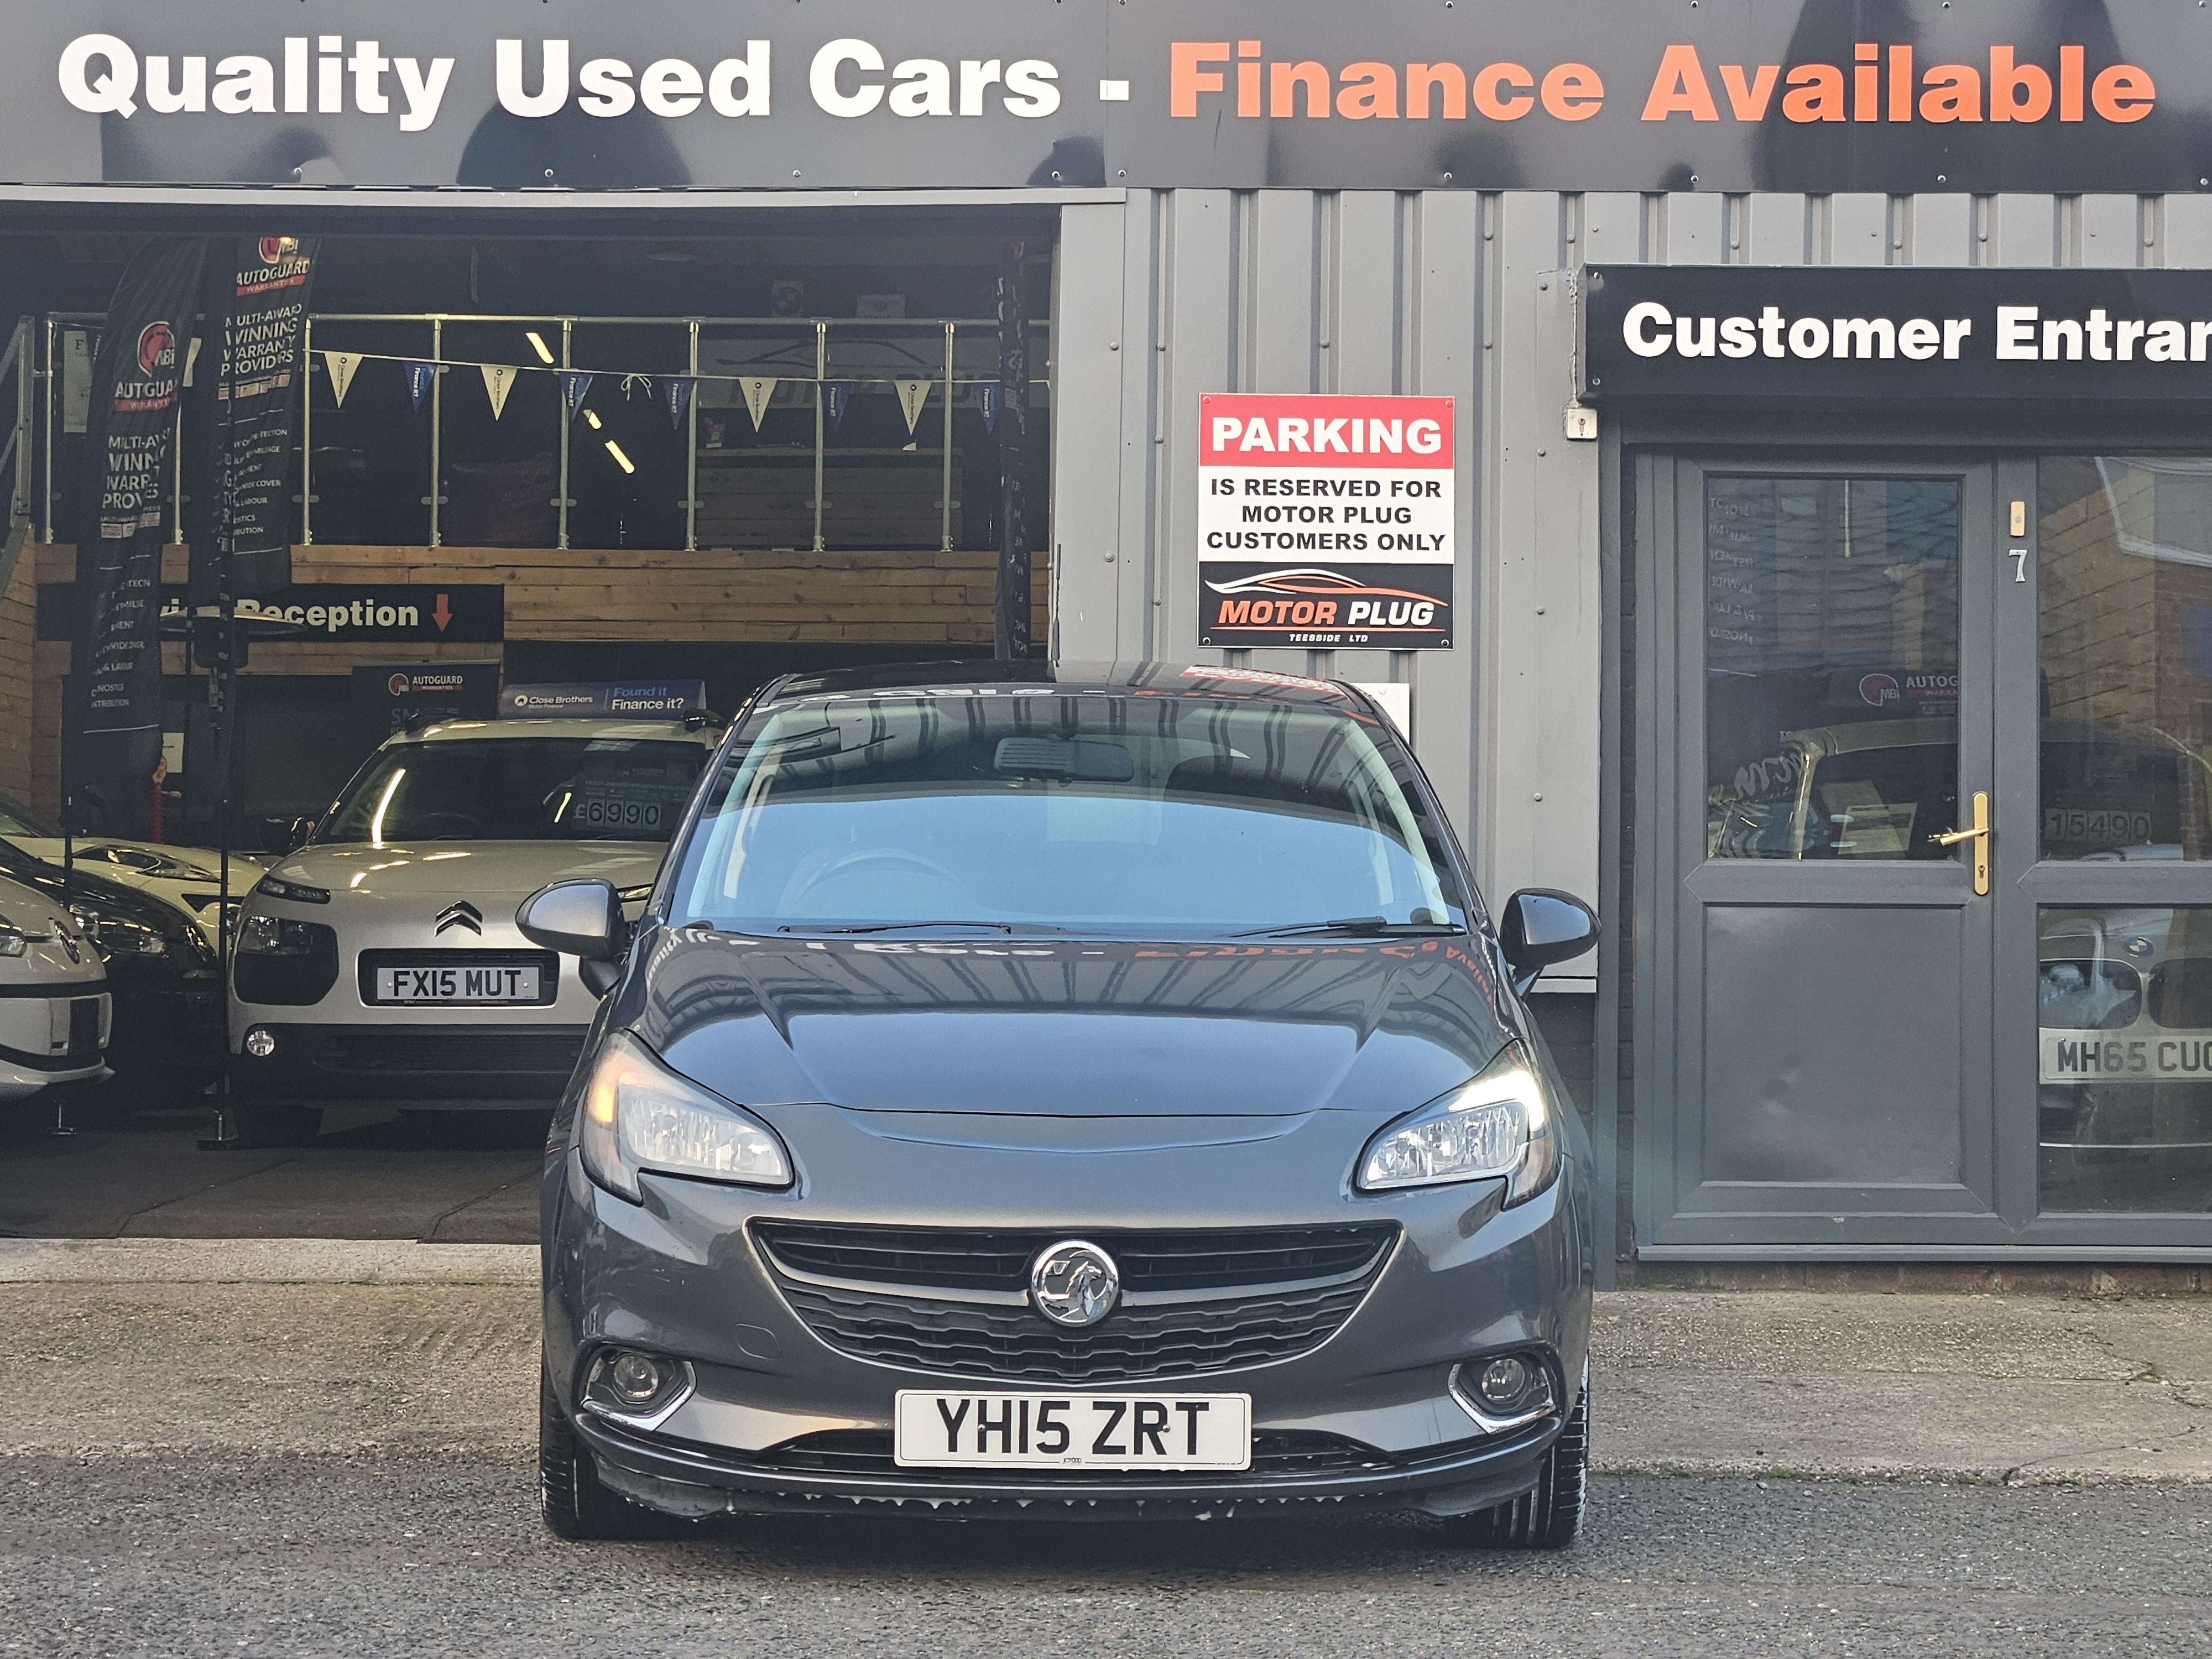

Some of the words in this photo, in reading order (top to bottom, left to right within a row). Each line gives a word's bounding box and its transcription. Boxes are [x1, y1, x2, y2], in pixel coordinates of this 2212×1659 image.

[58, 33, 455, 131] Quality
[496, 39, 770, 117] Used
[809, 38, 1061, 118] Cars
[1100, 80, 1129, 101] -
[1171, 41, 1604, 121] Finance
[1640, 43, 2156, 123] Available
[237, 260, 310, 285] AUTOGUARD
[1623, 302, 1971, 360] Customer
[223, 335, 296, 362] WARRANY
[221, 349, 294, 377] PROVIDRS
[1212, 417, 1442, 454] PARKING
[1211, 479, 1235, 495] IS
[1245, 479, 1381, 497] RESERVED
[1391, 481, 1442, 498] FOR
[1242, 505, 1334, 523] MOTOR
[1344, 507, 1412, 524] PLUG
[1207, 532, 1368, 550] CUSTOMERS
[1378, 534, 1446, 551] ONLY
[2008, 549, 2028, 582] 7
[1218, 601, 1338, 624] MOTOR
[1348, 602, 1434, 625] PLUG
[412, 675, 463, 685] AUTOGUARD
[613, 686, 656, 697] Found
[658, 686, 667, 696] it
[555, 695, 593, 704] Brothers
[611, 698, 664, 711] Finance
[666, 697, 685, 709] it?
[393, 971, 456, 997] FX15
[466, 970, 521, 996] MUT
[2058, 1041, 2147, 1072] MH65
[936, 1399, 1071, 1454] YH15
[1092, 1401, 1209, 1455] ZRT
